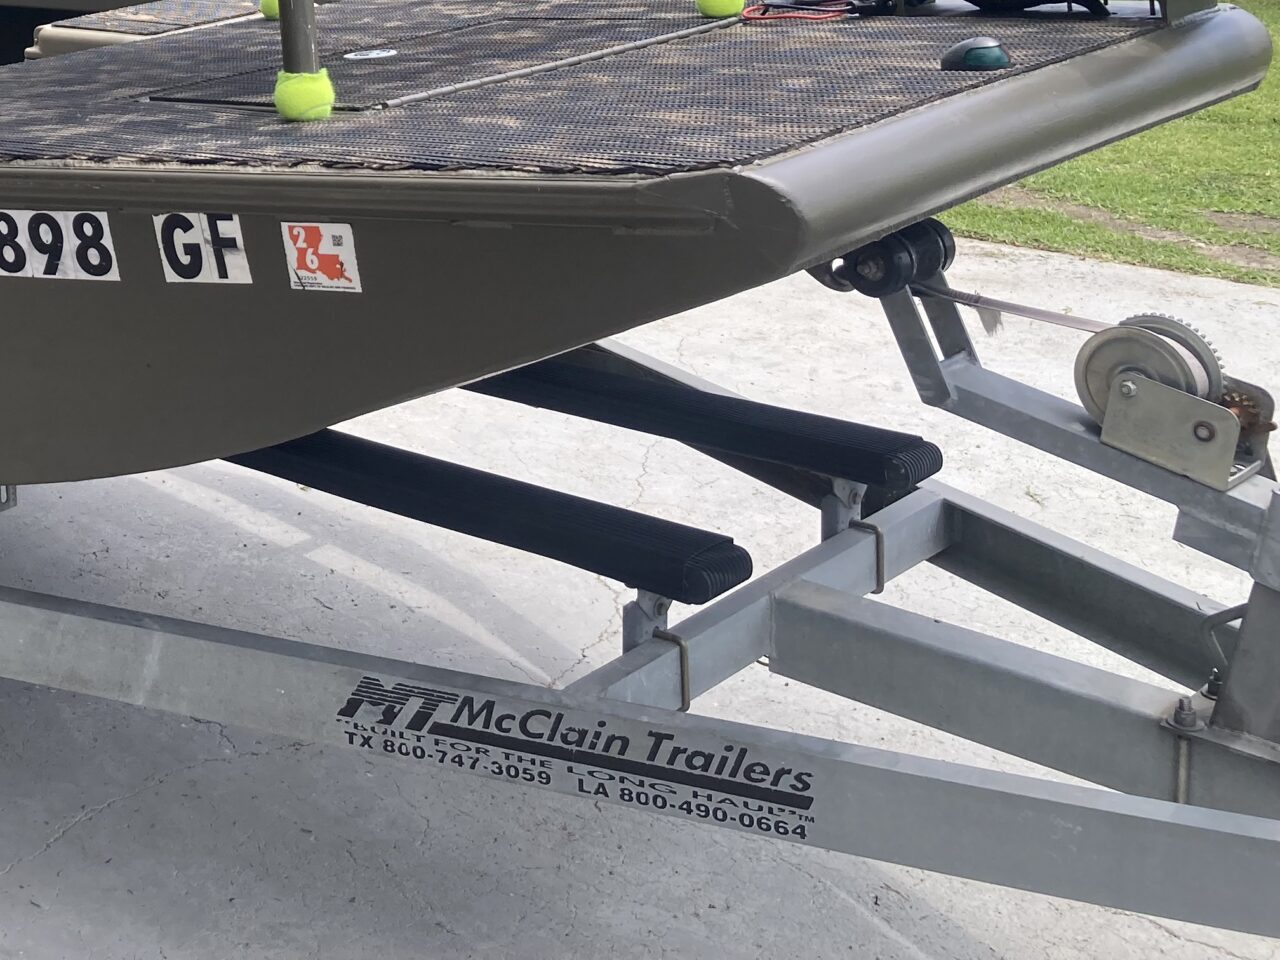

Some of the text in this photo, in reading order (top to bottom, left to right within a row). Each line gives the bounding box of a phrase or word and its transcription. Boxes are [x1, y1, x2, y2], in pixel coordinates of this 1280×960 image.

[161, 212, 238, 280] GF
[344, 730, 808, 840] TX 800-747-3059 LA 800-490-0664
[434, 738, 490, 758] FOR
[501, 751, 553, 770] THE
[566, 765, 677, 795] LONG
[449, 695, 630, 756] McClain
[646, 729, 814, 793] Trailers
